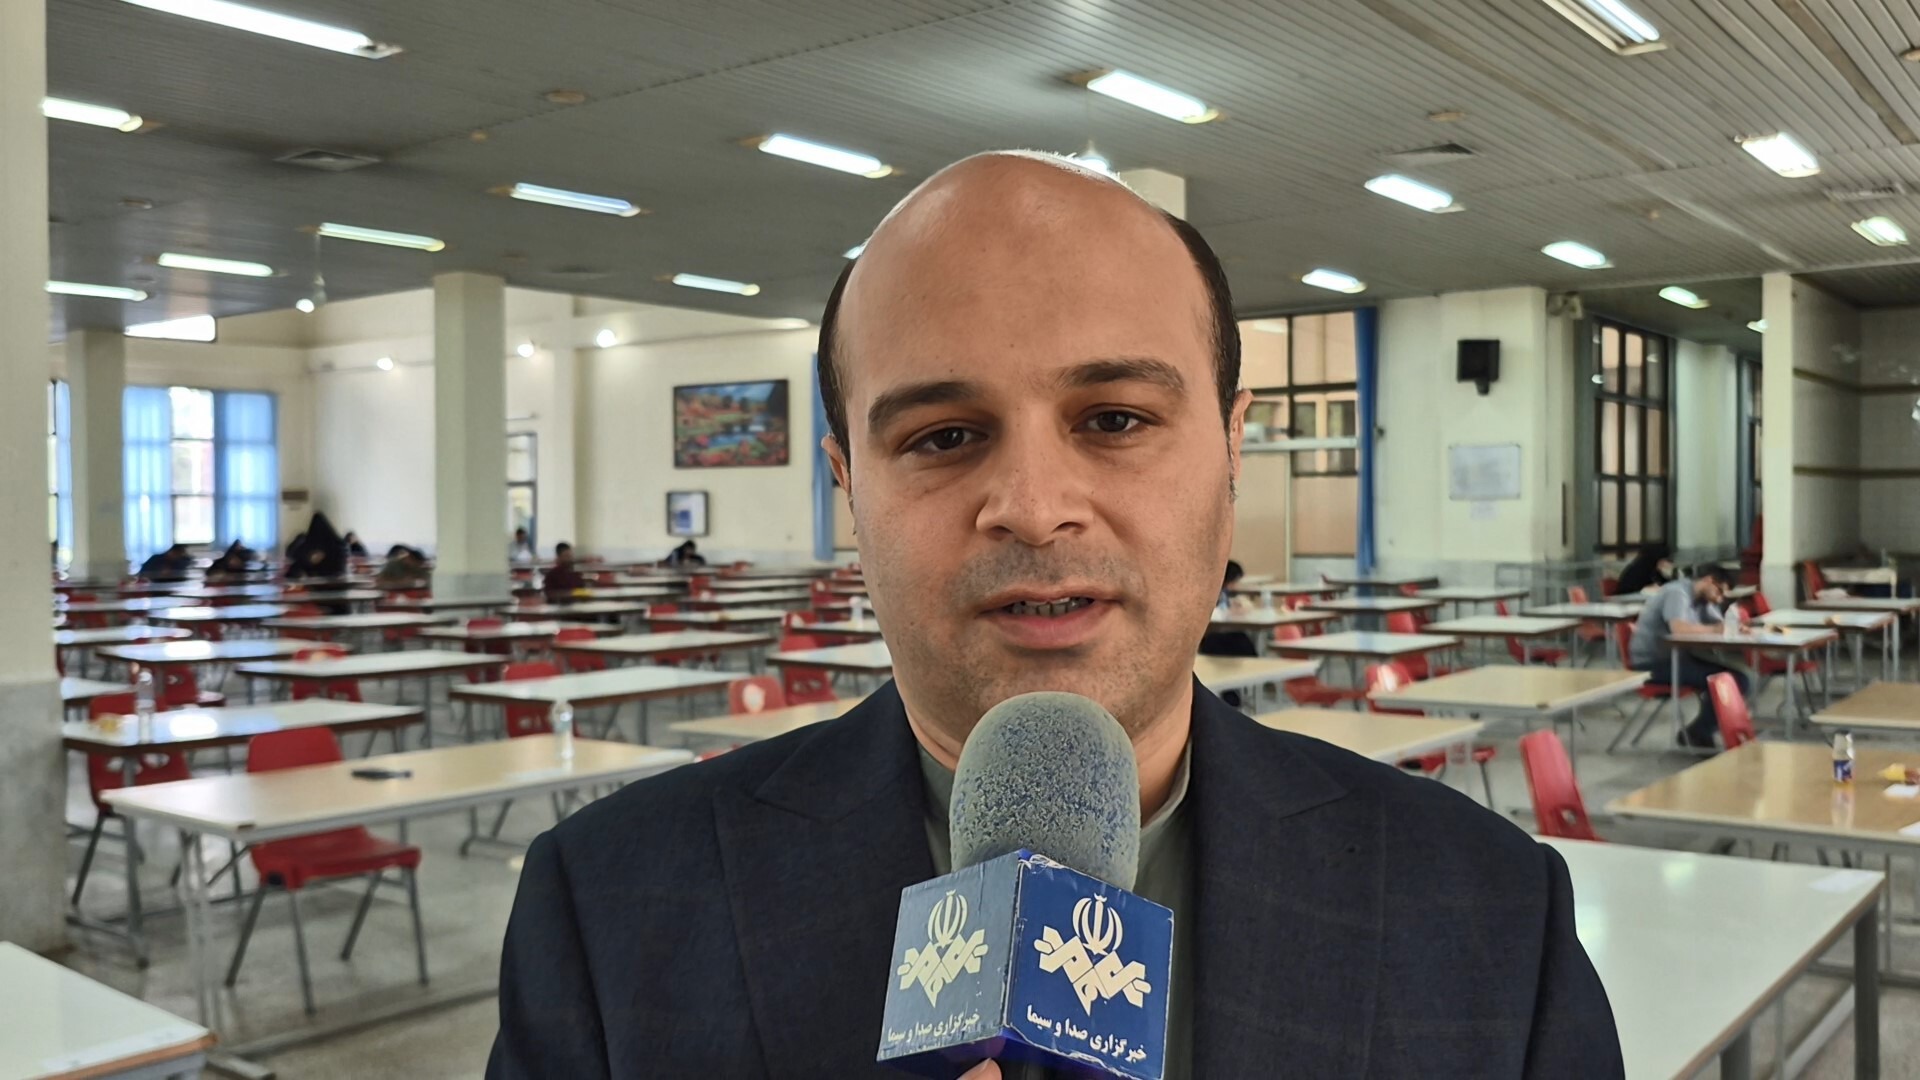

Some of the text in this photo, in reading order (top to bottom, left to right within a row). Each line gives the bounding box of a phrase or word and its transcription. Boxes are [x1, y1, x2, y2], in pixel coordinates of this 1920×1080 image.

[1026, 1004, 1053, 1030] سیما
[887, 1027, 907, 1043] سیما
[906, 1028, 913, 1043] و
[915, 1021, 933, 1036] صدا
[1053, 1021, 1062, 1037] و
[1065, 1017, 1089, 1040] صدا
